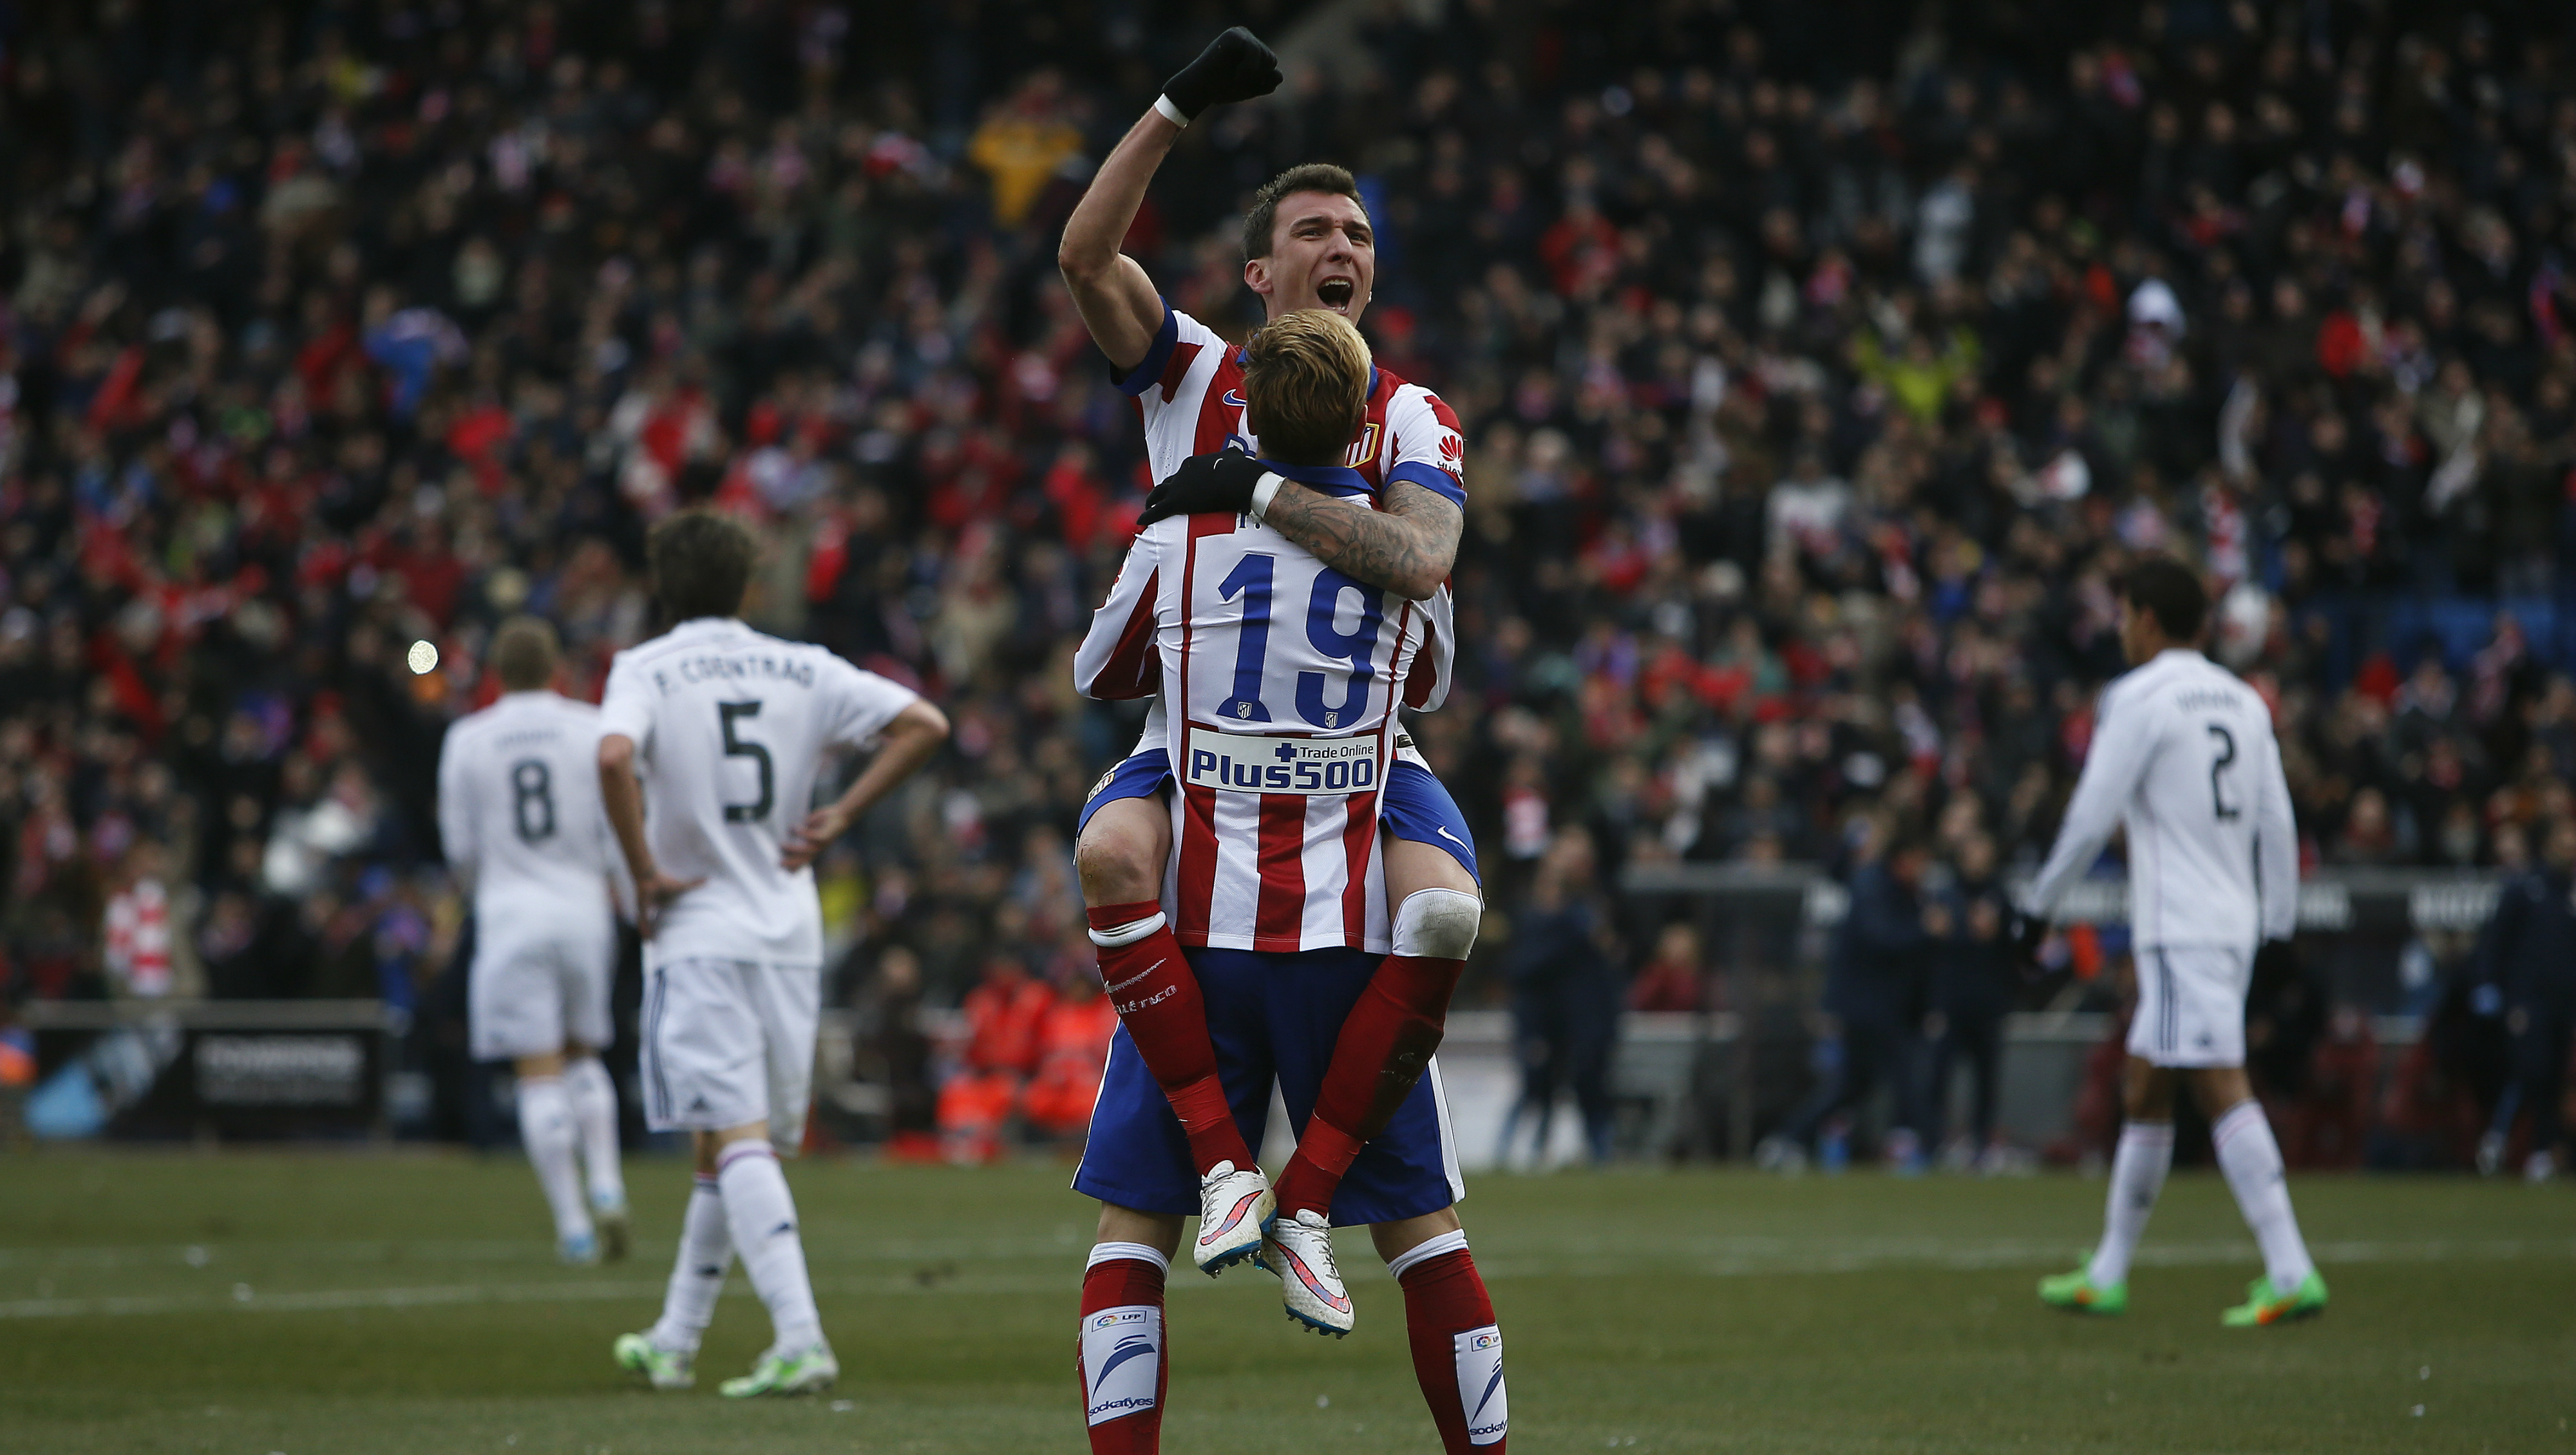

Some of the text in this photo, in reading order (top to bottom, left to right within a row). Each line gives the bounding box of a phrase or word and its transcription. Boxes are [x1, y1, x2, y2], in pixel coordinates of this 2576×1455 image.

[1217, 554, 1385, 729] 19
[719, 700, 774, 822] 5
[1191, 748, 1374, 790] Plus500
[1300, 744, 1374, 758] Trade Online
[2207, 722, 2240, 821] 2
[511, 756, 558, 845] 8
